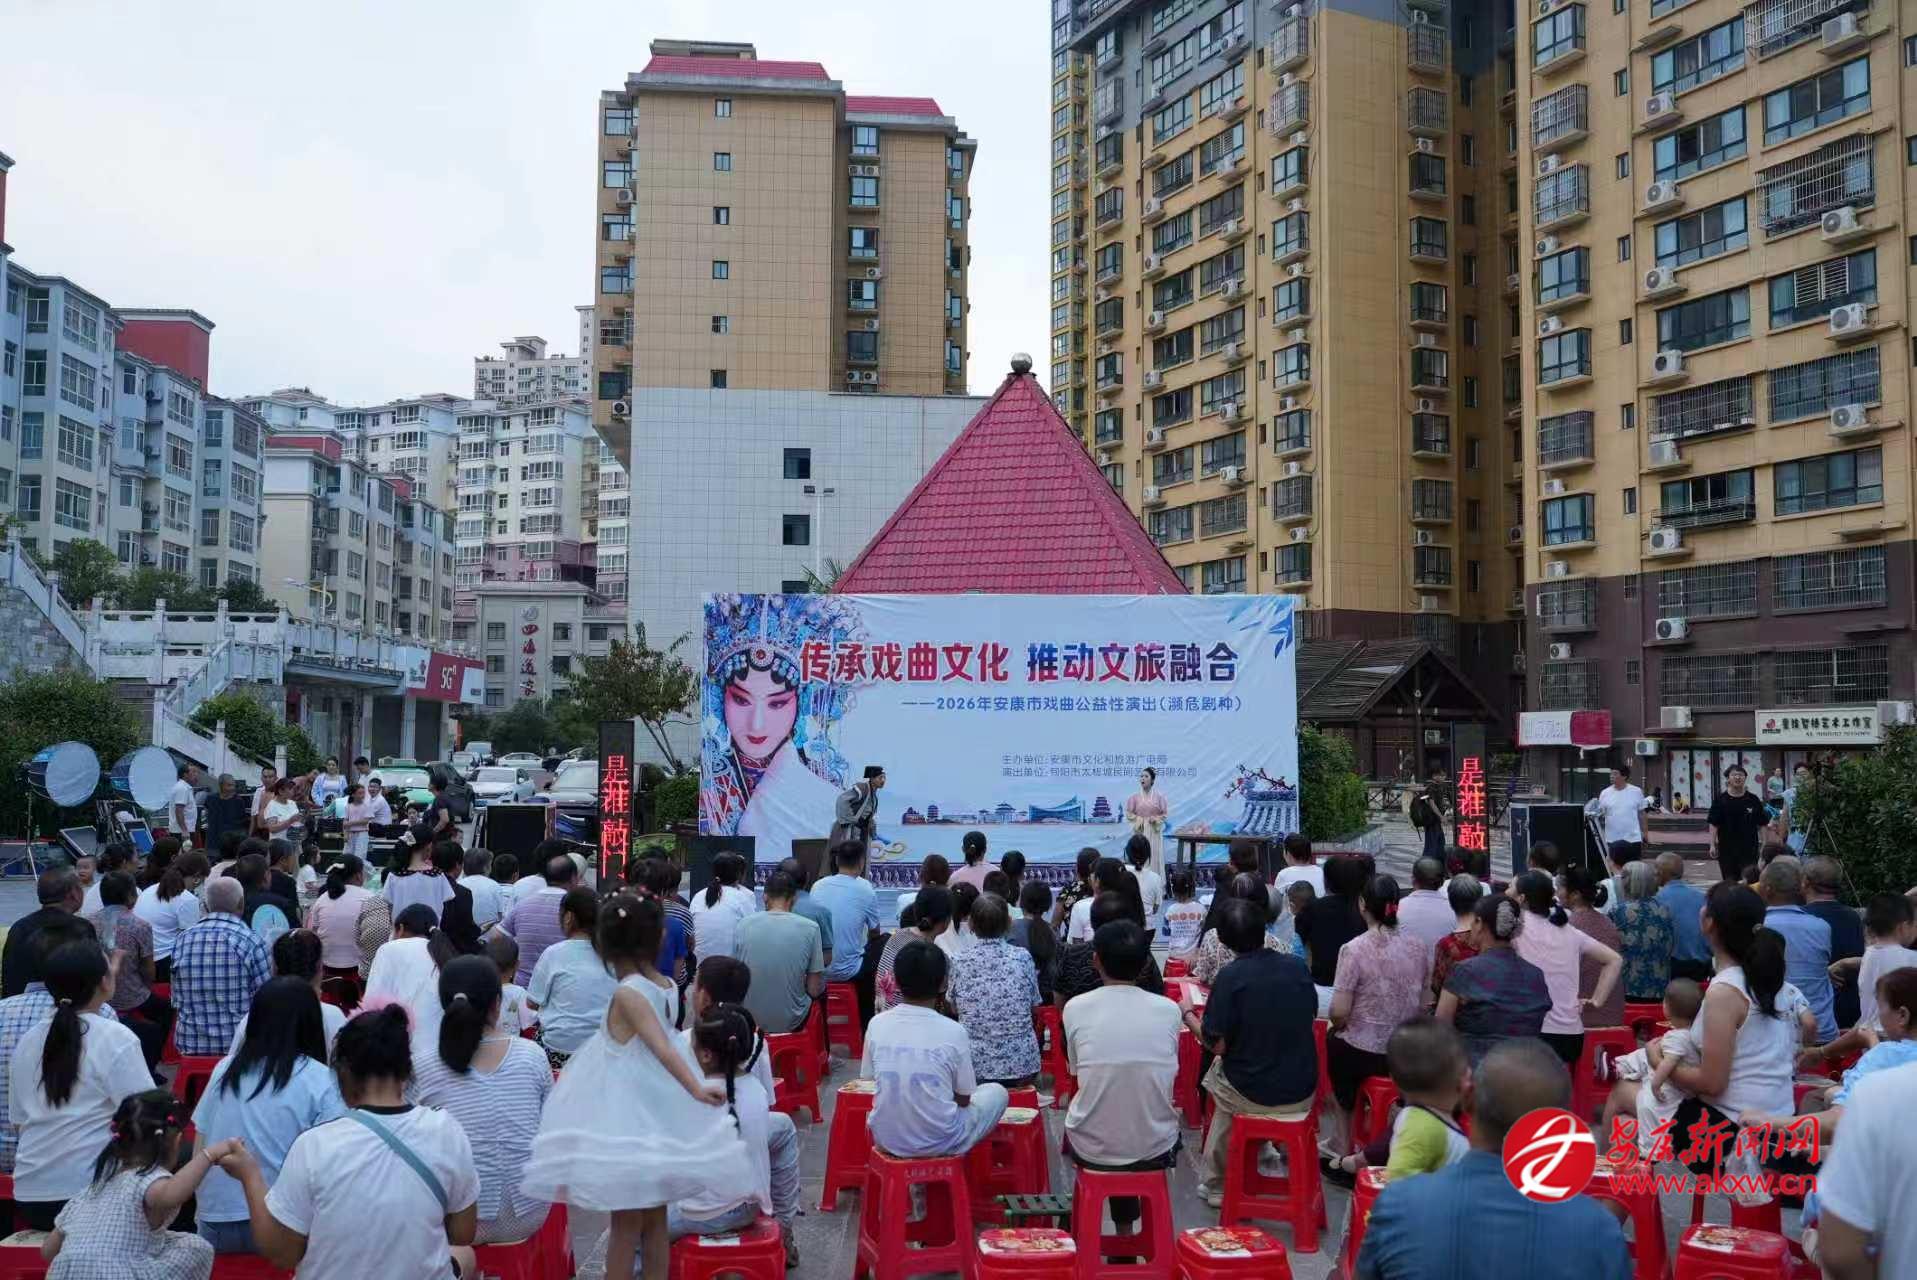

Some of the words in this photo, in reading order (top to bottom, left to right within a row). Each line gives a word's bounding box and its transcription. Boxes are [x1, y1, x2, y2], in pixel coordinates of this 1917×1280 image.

[799, 641, 1010, 683] 传承戏曲文化
[1026, 641, 1240, 683] 推动文旅融合
